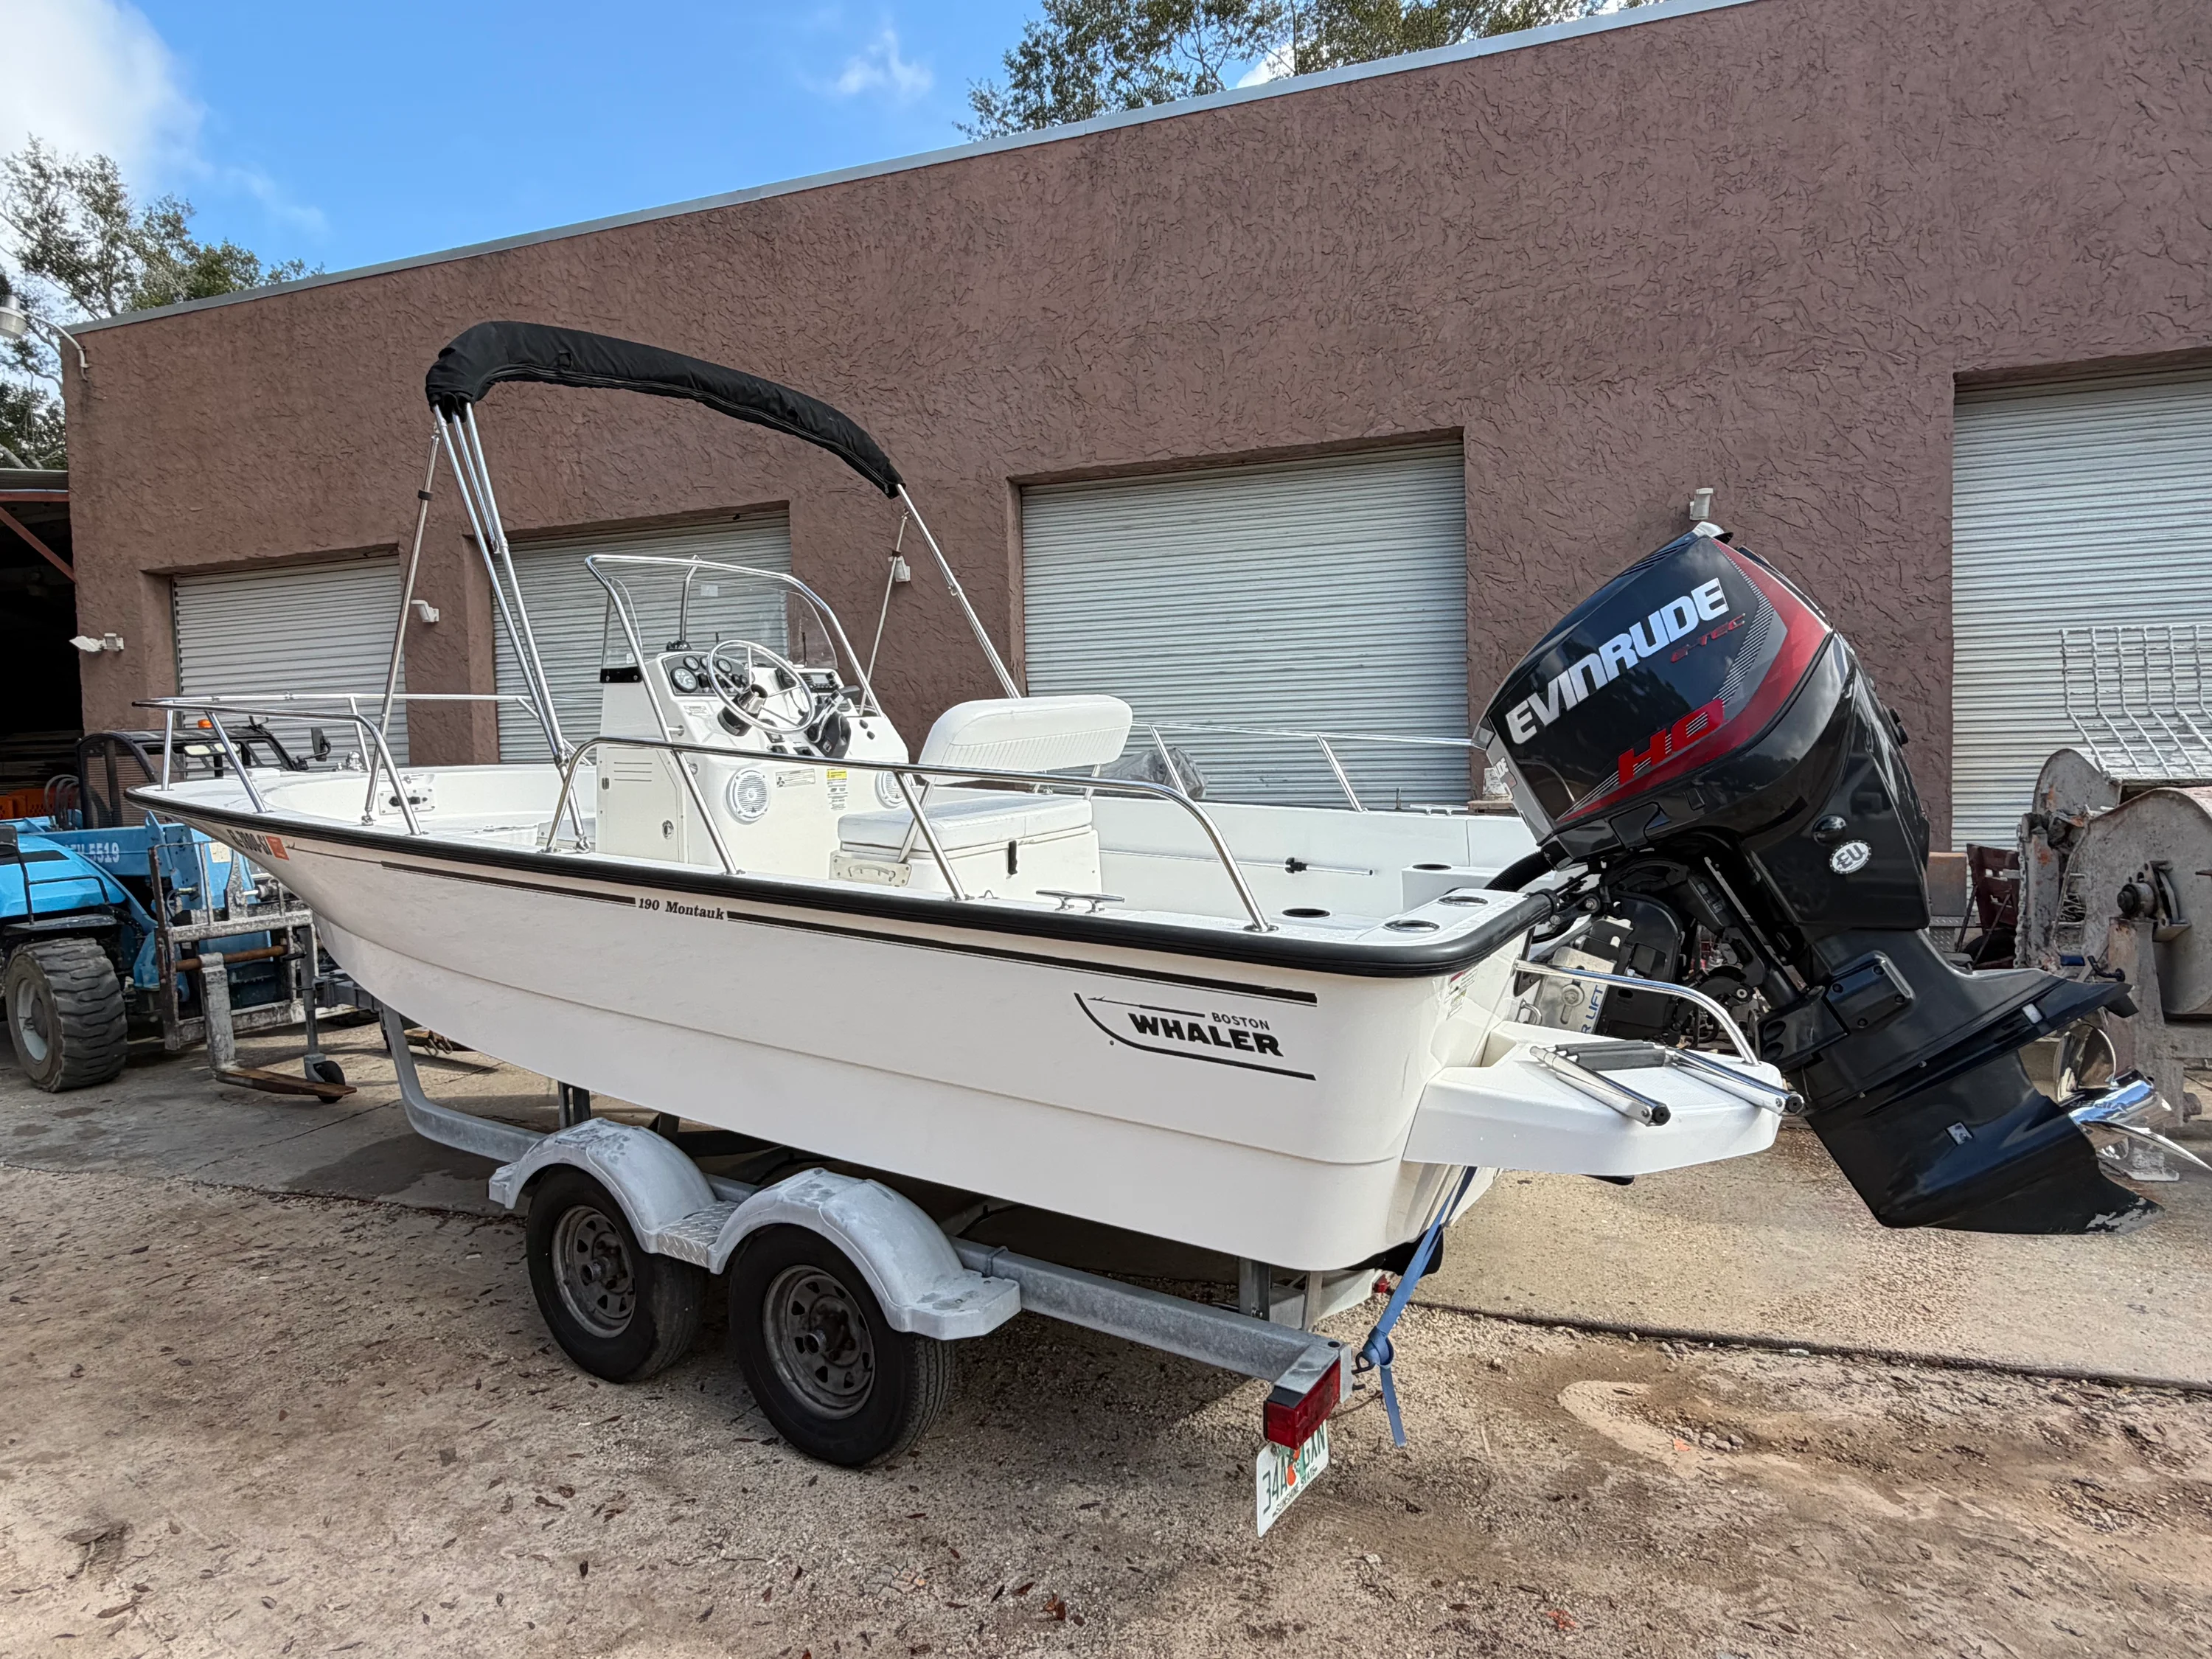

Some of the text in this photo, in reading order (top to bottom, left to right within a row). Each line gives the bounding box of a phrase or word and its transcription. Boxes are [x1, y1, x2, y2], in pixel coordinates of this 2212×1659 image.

[1505, 577, 1730, 745] EVINRUDE
[1618, 698, 1725, 785] HO
[638, 897, 725, 920] 190 Montauk
[1211, 1012, 1270, 1031] BOSTON
[1585, 984, 1603, 1020] LIFT
[1127, 1012, 1284, 1057] WHALER
